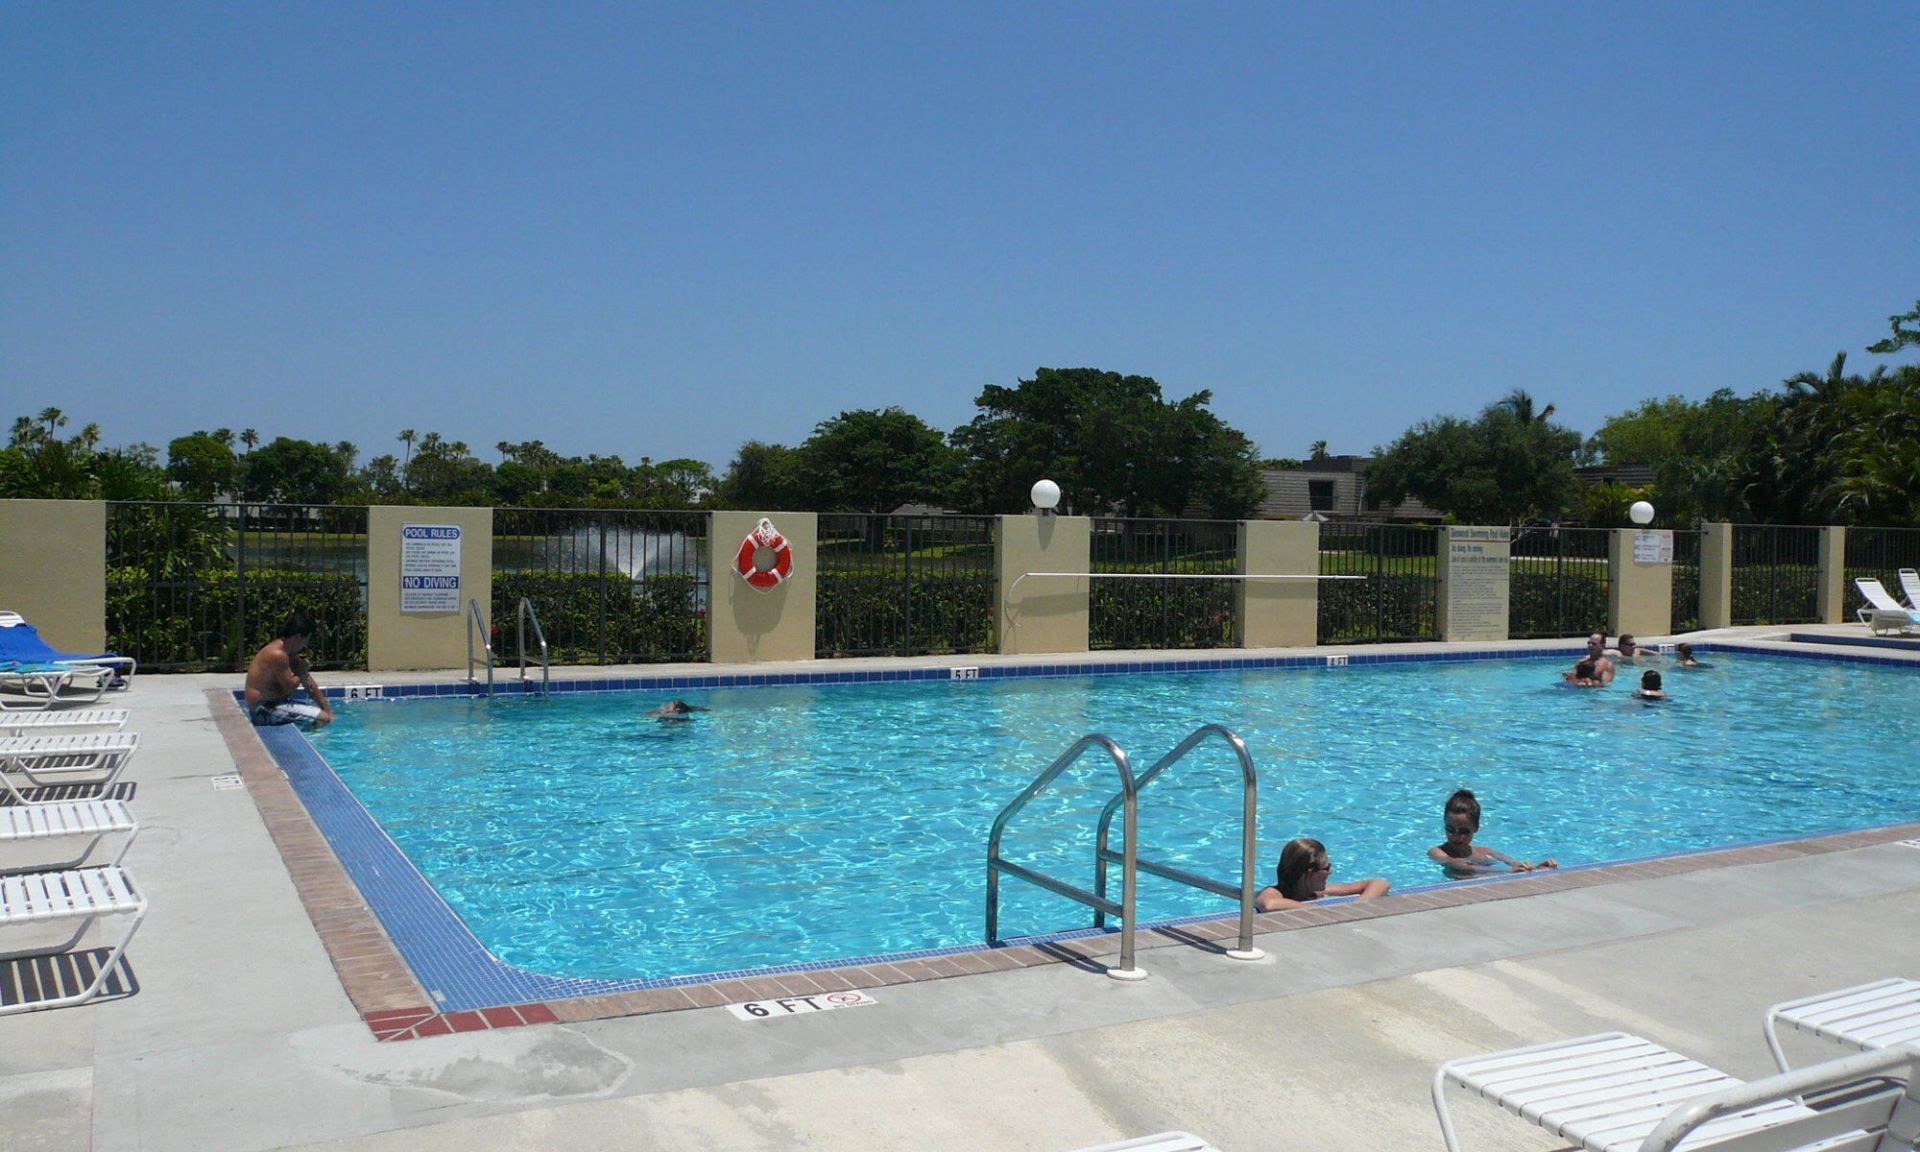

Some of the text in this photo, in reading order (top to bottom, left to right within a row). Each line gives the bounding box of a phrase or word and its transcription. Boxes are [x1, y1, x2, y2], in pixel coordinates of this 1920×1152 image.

[405, 528, 458, 539] POOL RULES
[405, 577, 457, 588] NO DIVING
[1338, 656, 1346, 666] FT
[965, 669, 978, 679] FT
[350, 687, 382, 699] 6 FT
[743, 996, 822, 1017] 6 FT
